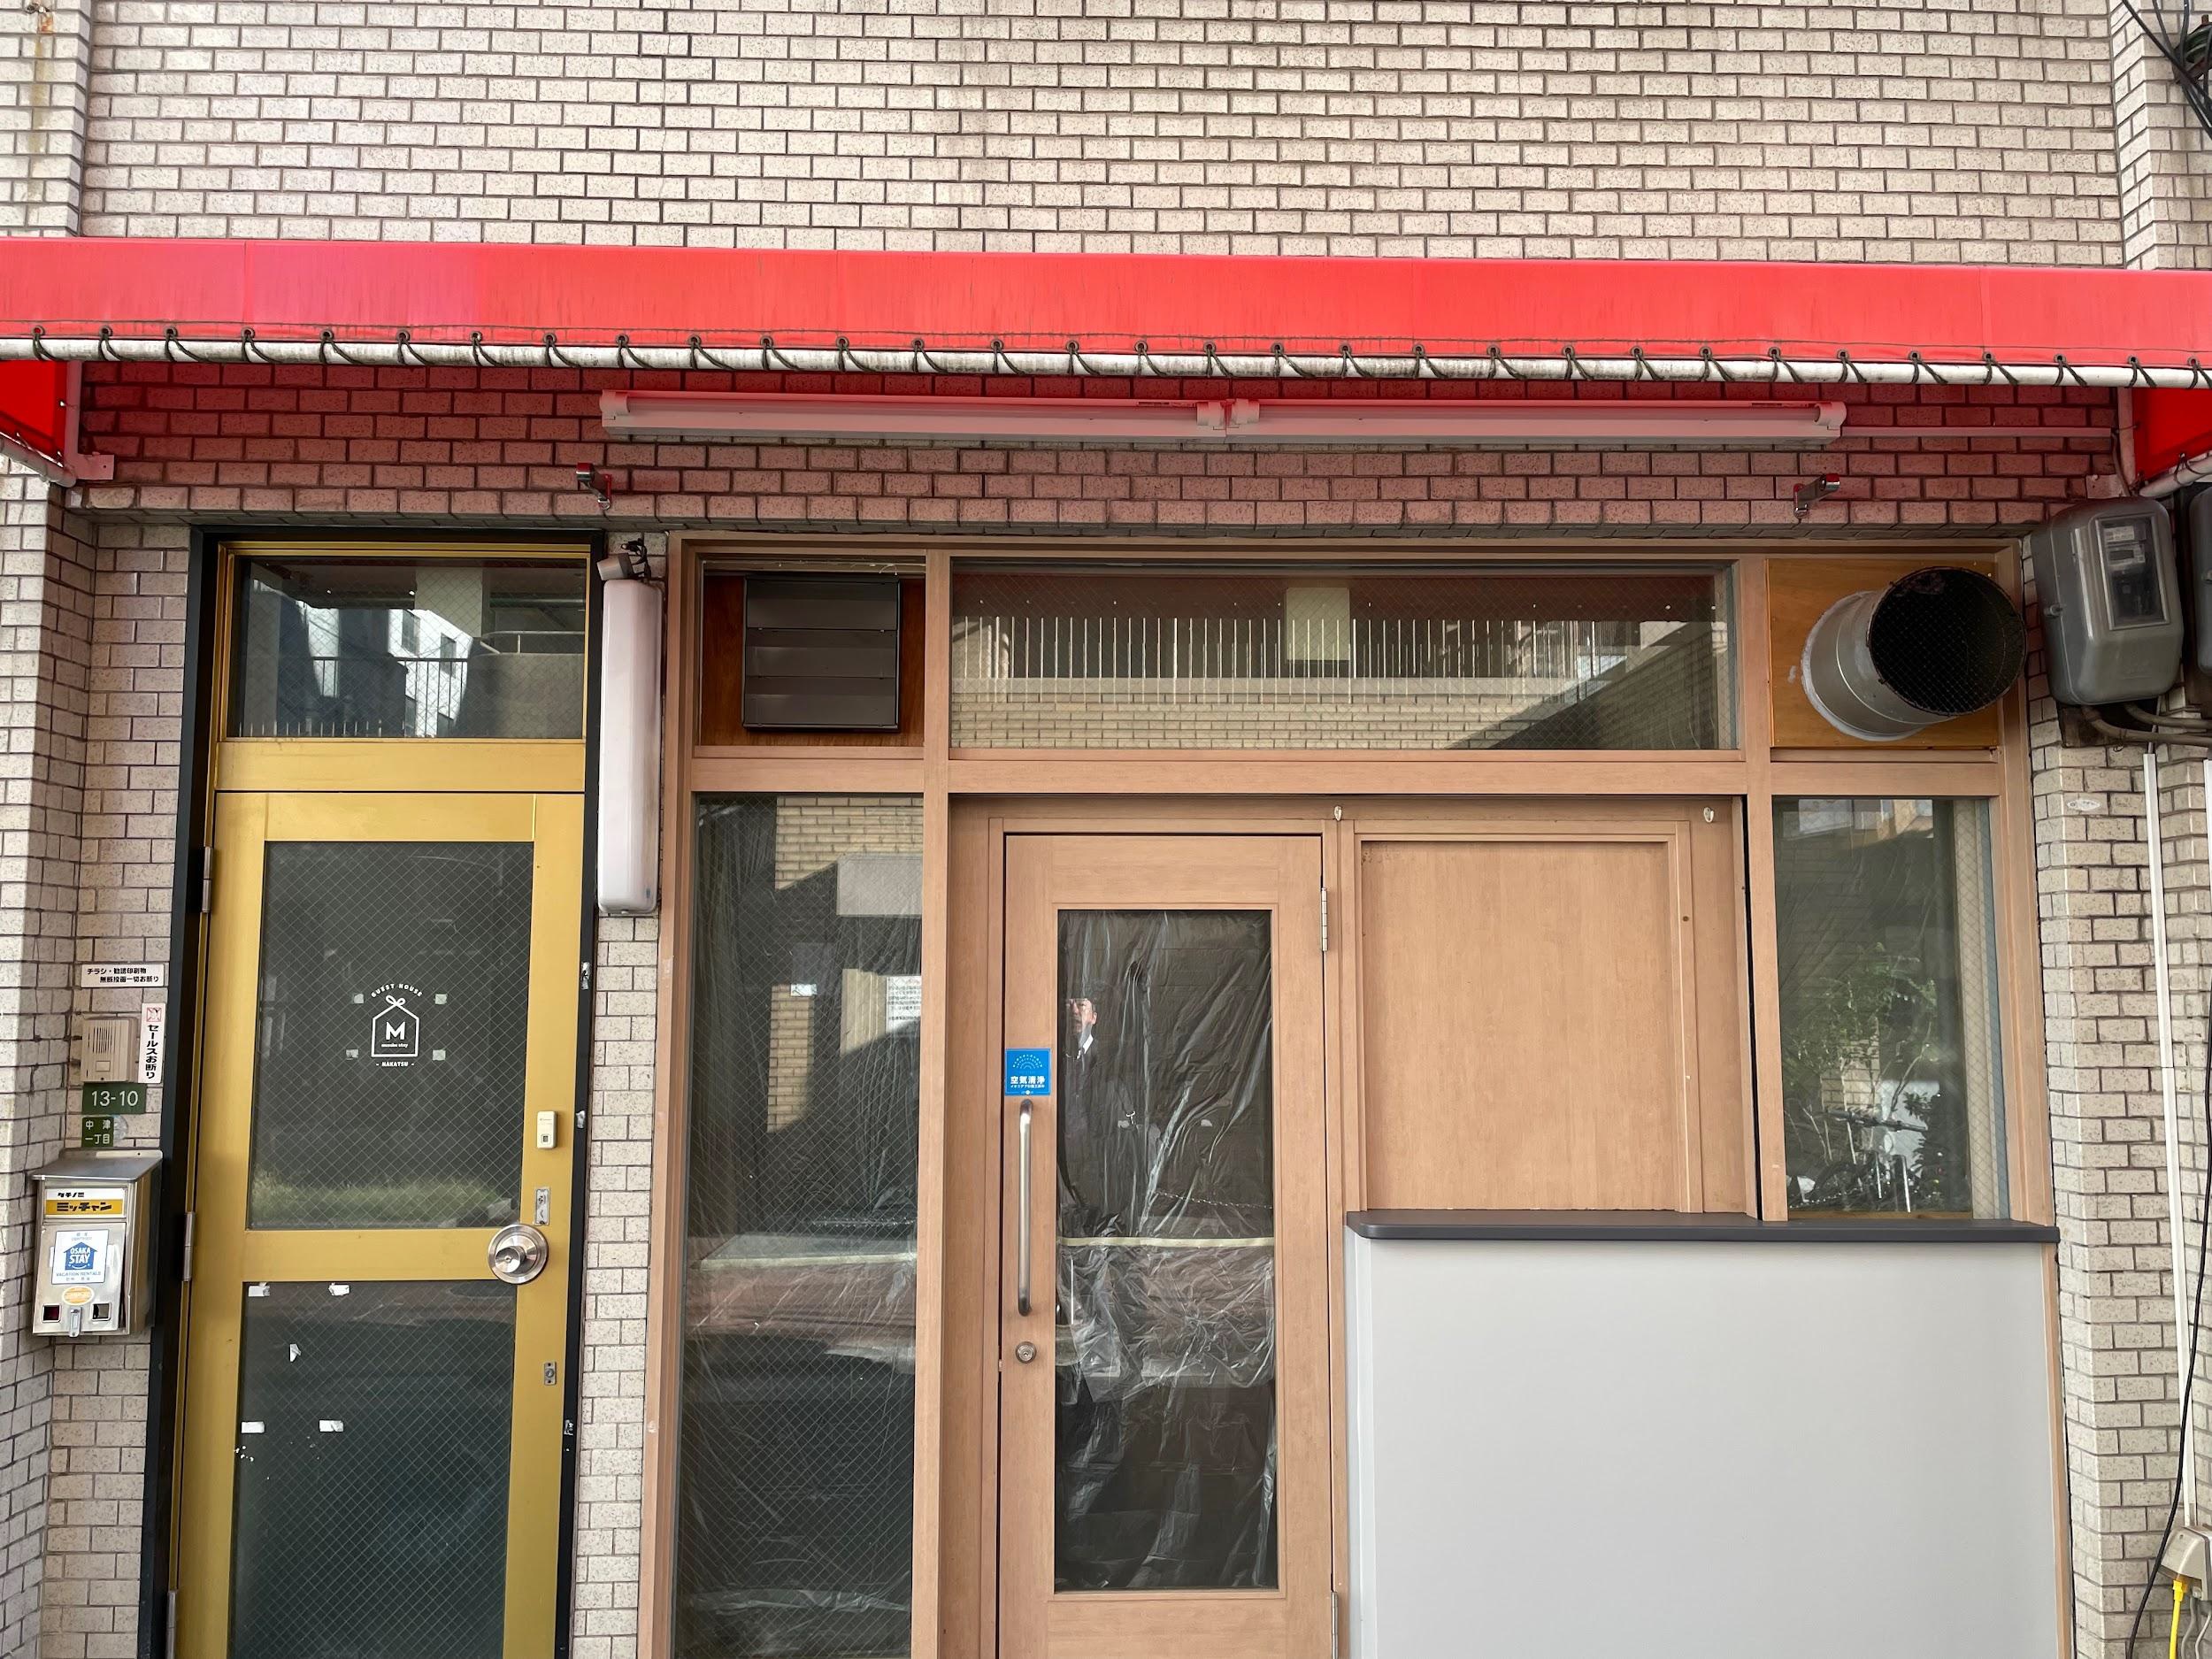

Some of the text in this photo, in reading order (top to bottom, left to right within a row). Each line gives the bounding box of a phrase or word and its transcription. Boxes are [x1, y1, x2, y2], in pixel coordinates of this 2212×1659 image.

[371, 983, 423, 998] GUEST HOUSE
[386, 1021, 406, 1041] M
[145, 1025, 159, 1079] セールスお断り
[91, 1090, 139, 1107] 13-10
[84, 1133, 111, 1144] 一丁目
[57, 1202, 112, 1211] ミッチャン
[68, 1254, 91, 1264] STAY
